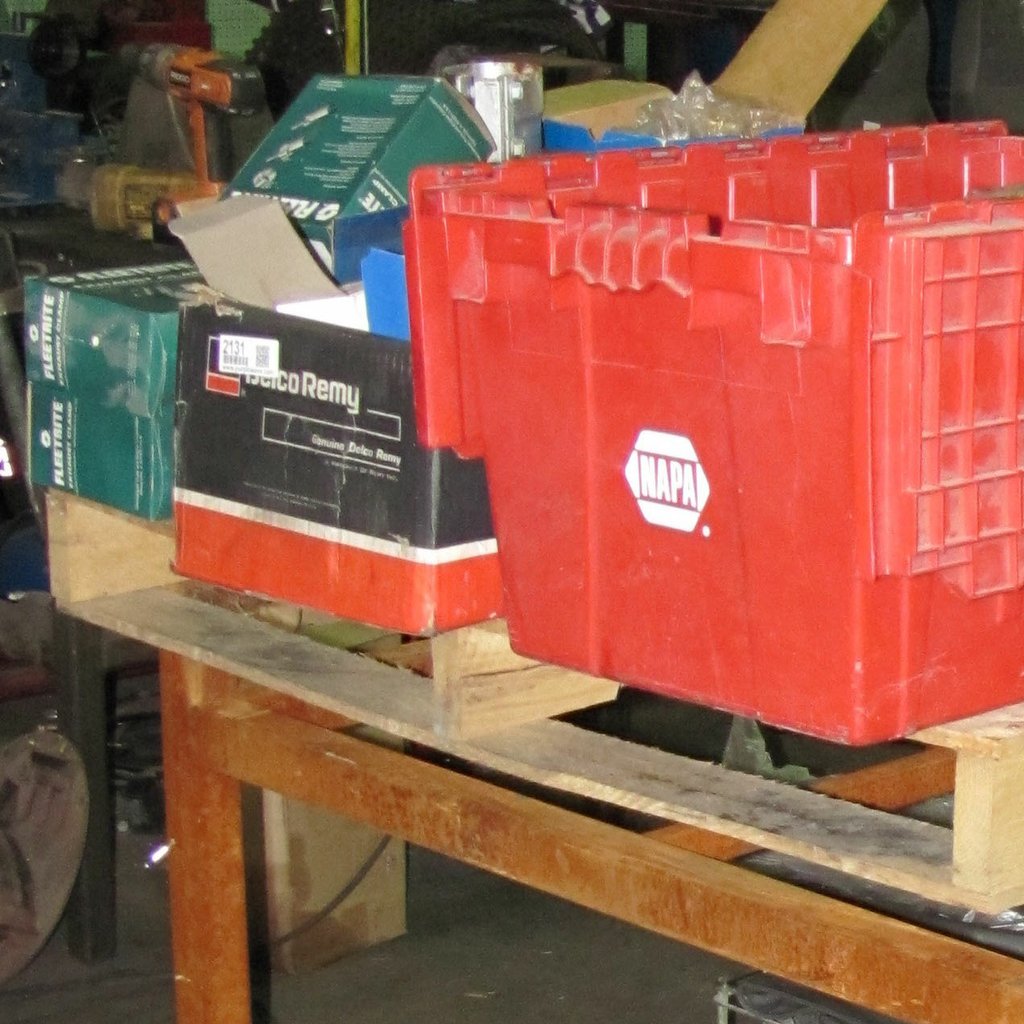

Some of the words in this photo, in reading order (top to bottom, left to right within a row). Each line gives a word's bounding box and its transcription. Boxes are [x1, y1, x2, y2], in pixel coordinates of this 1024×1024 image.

[42, 293, 55, 381] FLEETRITE
[222, 339, 245, 356] 2131
[302, 370, 360, 415] Remy
[53, 400, 65, 486] FLEETRITE
[311, 433, 345, 451] Genuine
[349, 441, 374, 457] Delco
[376, 449, 401, 466] Remy
[640, 454, 698, 509] NAPA
